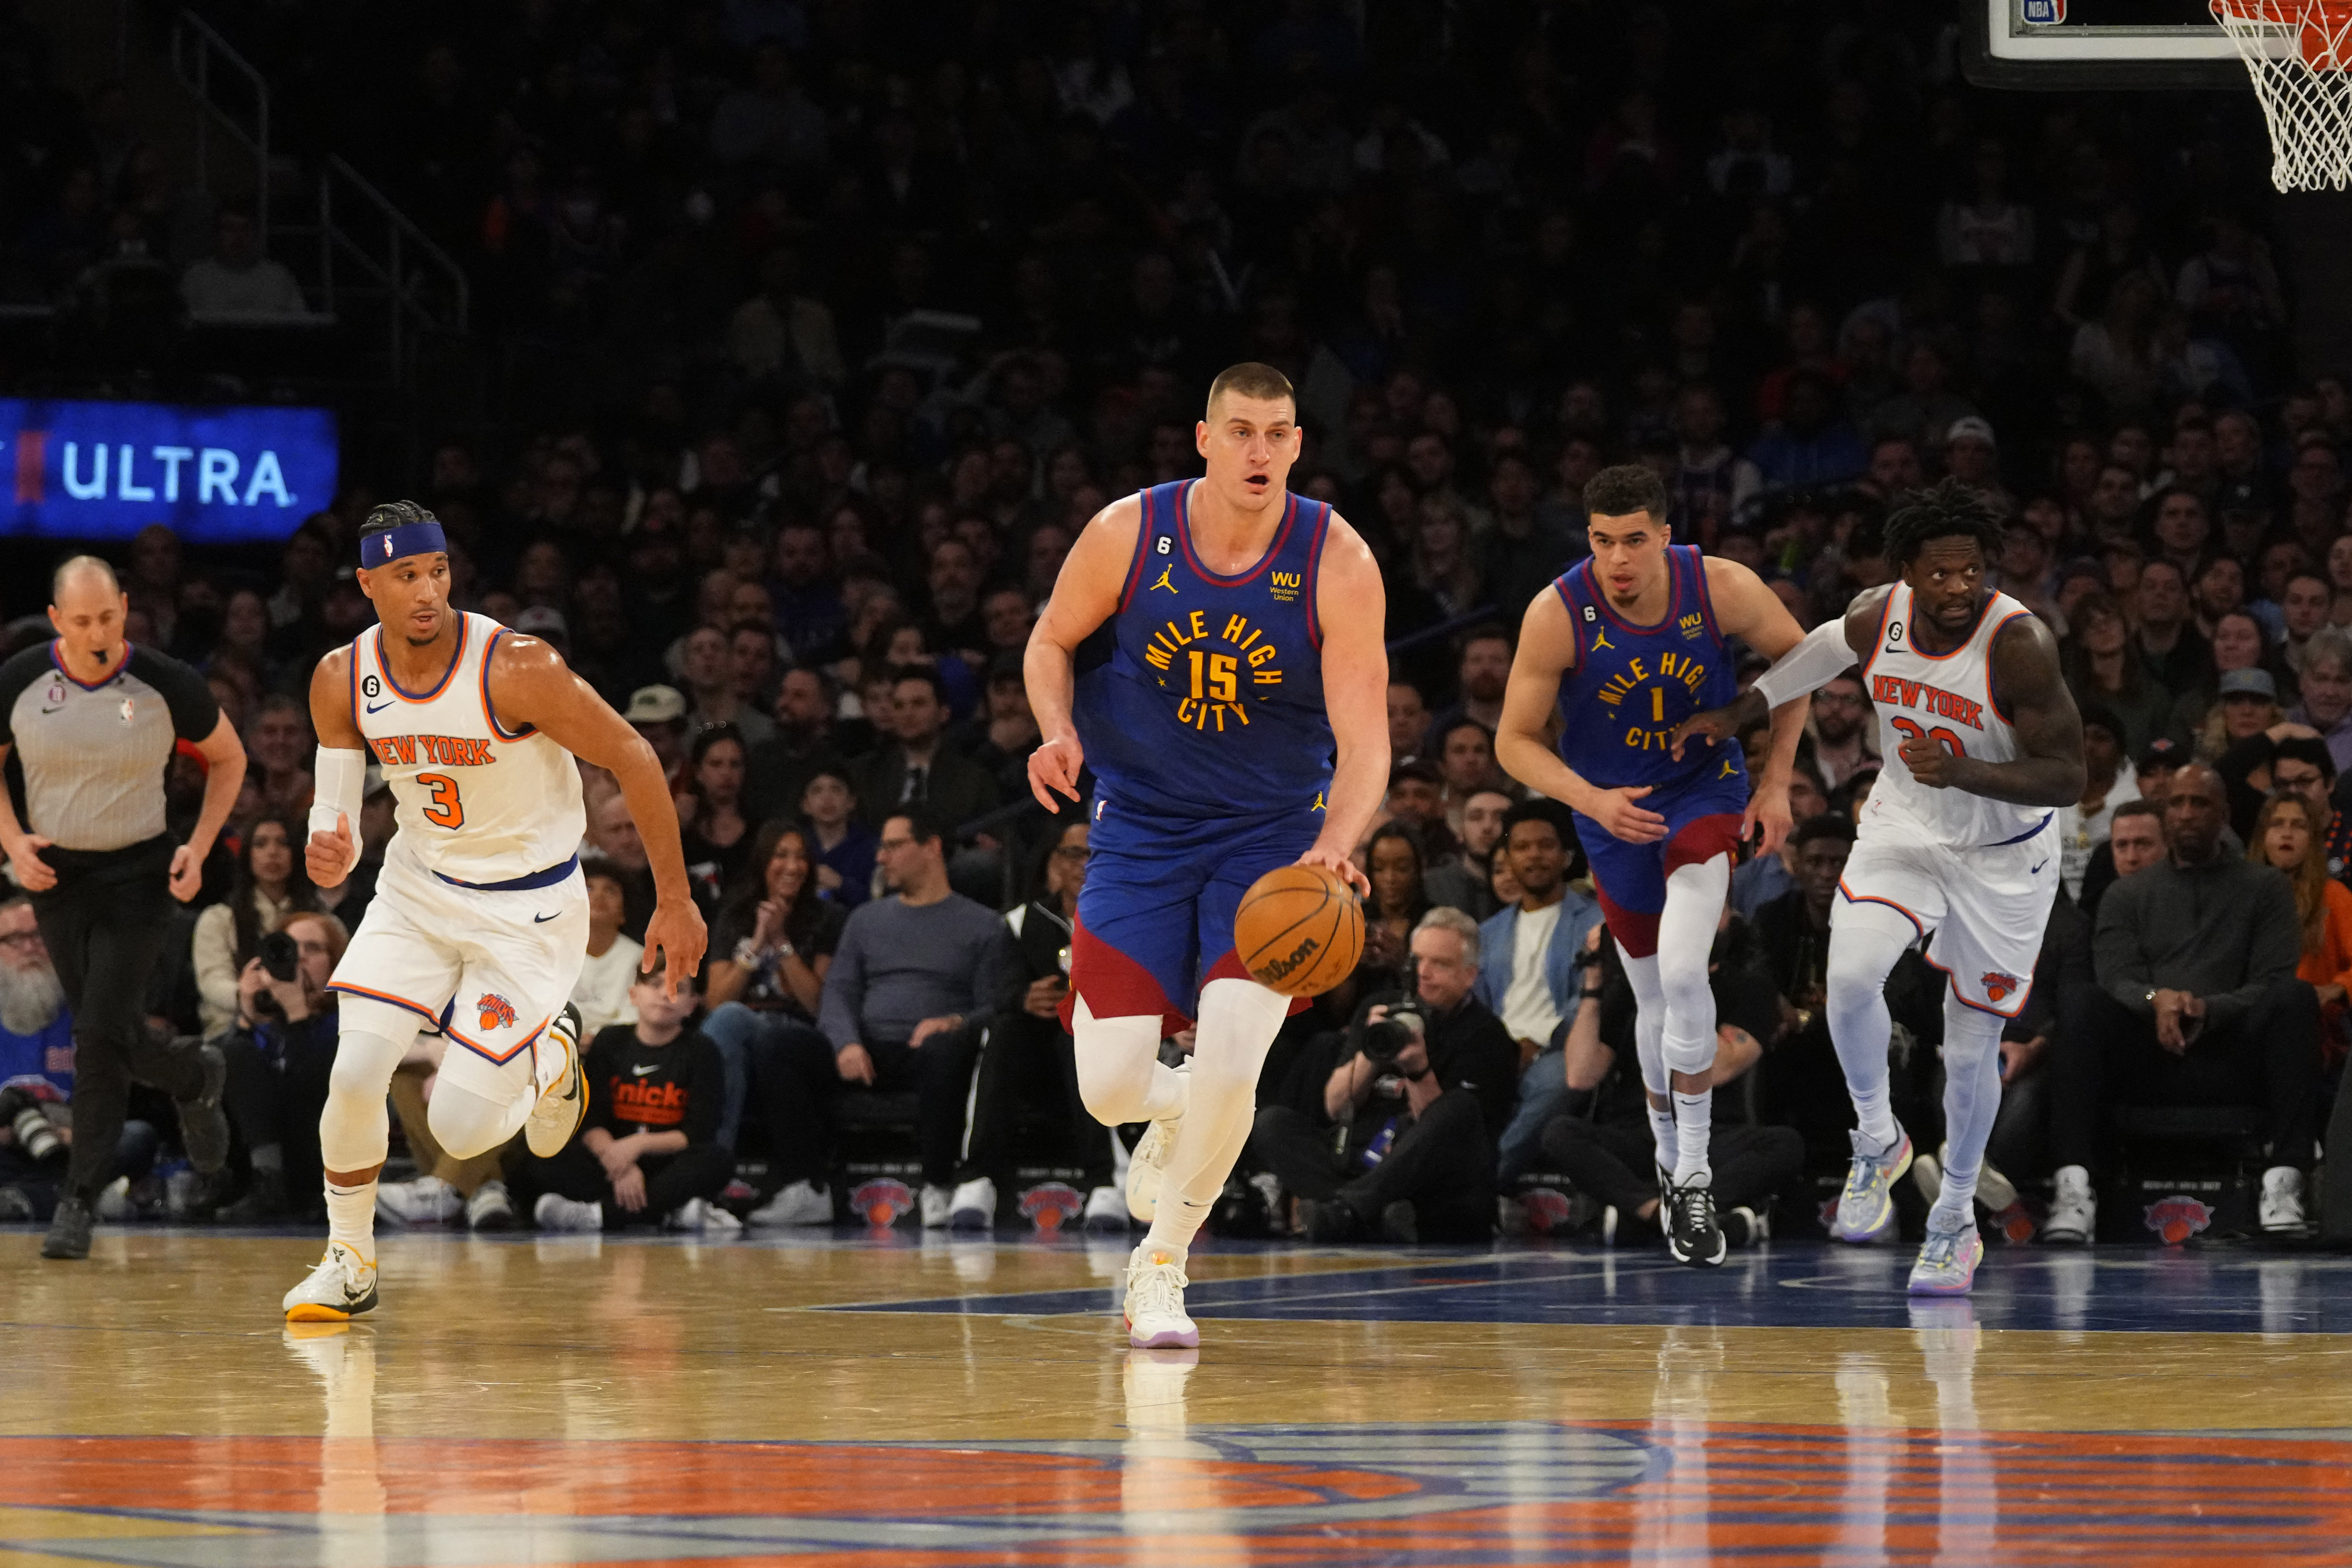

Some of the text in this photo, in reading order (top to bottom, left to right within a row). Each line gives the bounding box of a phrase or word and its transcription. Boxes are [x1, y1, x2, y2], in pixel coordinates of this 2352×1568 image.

[2028, 1, 2050, 18] NBA
[1158, 536, 1172, 555] 6
[1269, 586, 1299, 596] Western
[1271, 571, 1301, 588] WU
[1274, 593, 1294, 602] Union
[1584, 606, 1596, 622] 6
[1679, 612, 1702, 629] WU
[1891, 624, 1902, 639] 6
[1145, 610, 1283, 684] MILE HIGH
[367, 678, 378, 695] 6
[1188, 651, 1238, 702] 15
[1597, 657, 1650, 706] MILE
[1177, 696, 1250, 732] CITY
[1649, 686, 1664, 722] 1
[1873, 674, 1984, 732] NEW YORK
[367, 734, 496, 766] NEW YORK
[1625, 723, 1680, 750] CIT
[415, 772, 465, 830] 3
[1253, 937, 1320, 985] Wilson
